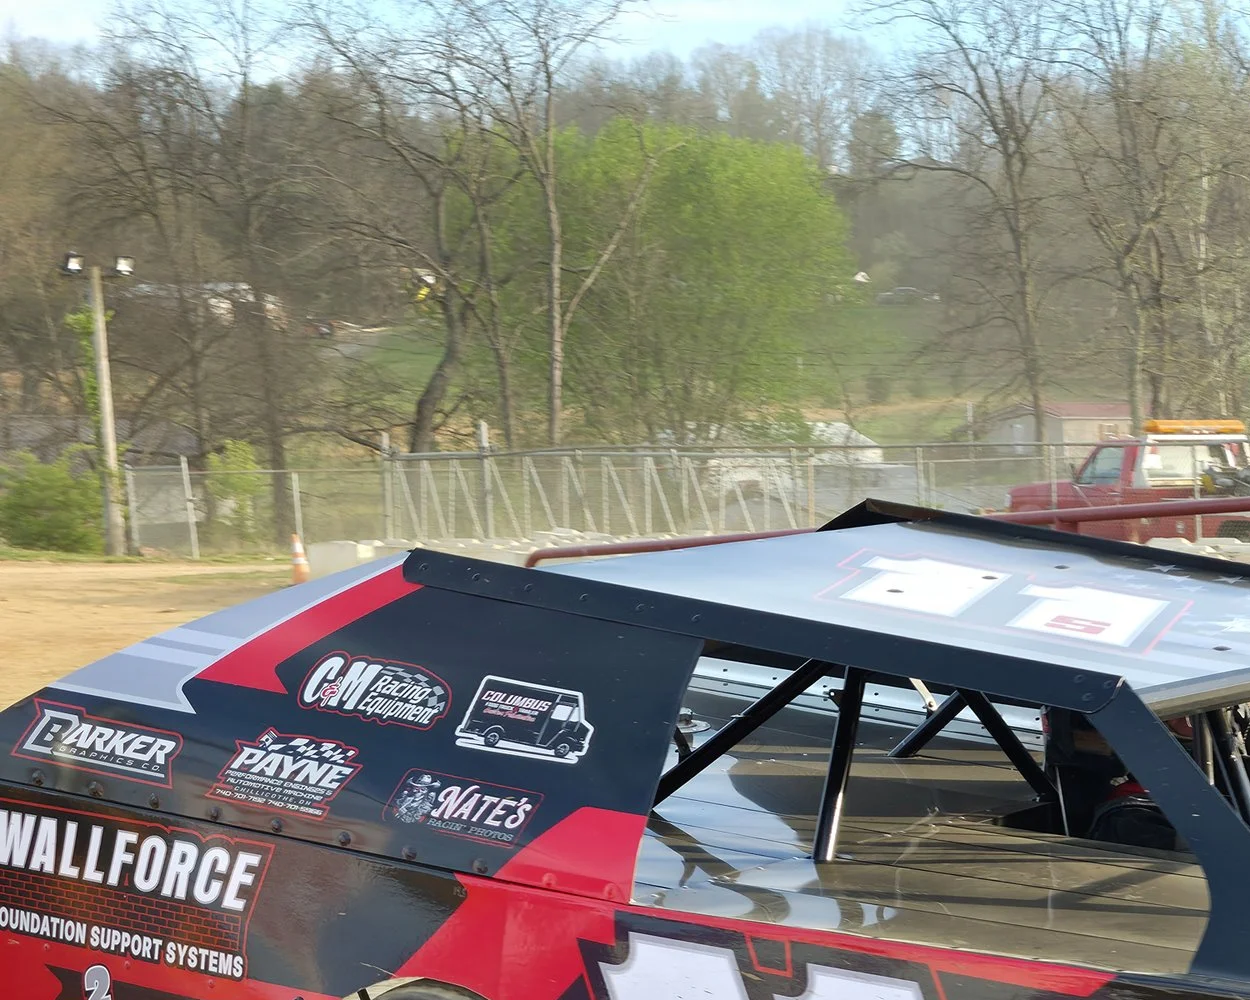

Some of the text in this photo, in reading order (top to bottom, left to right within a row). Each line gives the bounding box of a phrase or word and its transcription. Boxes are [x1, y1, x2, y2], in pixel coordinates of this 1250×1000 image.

[370, 675, 433, 704] Racing
[481, 690, 552, 712] COLUMBUS
[357, 691, 439, 725] Equipment
[23, 708, 177, 765] BARKER
[58, 745, 161, 772] GRAPHICS CO.
[230, 746, 354, 789] PAYNE
[225, 769, 283, 787] PERFORMANCE
[226, 777, 324, 801] AUTOMOTIVE MACHINE
[468, 825, 514, 842] PHOTOS
[0, 809, 262, 912] WALLFORCE
[90, 925, 163, 961] SUPPORT
[165, 942, 244, 978] SYSTEMS
